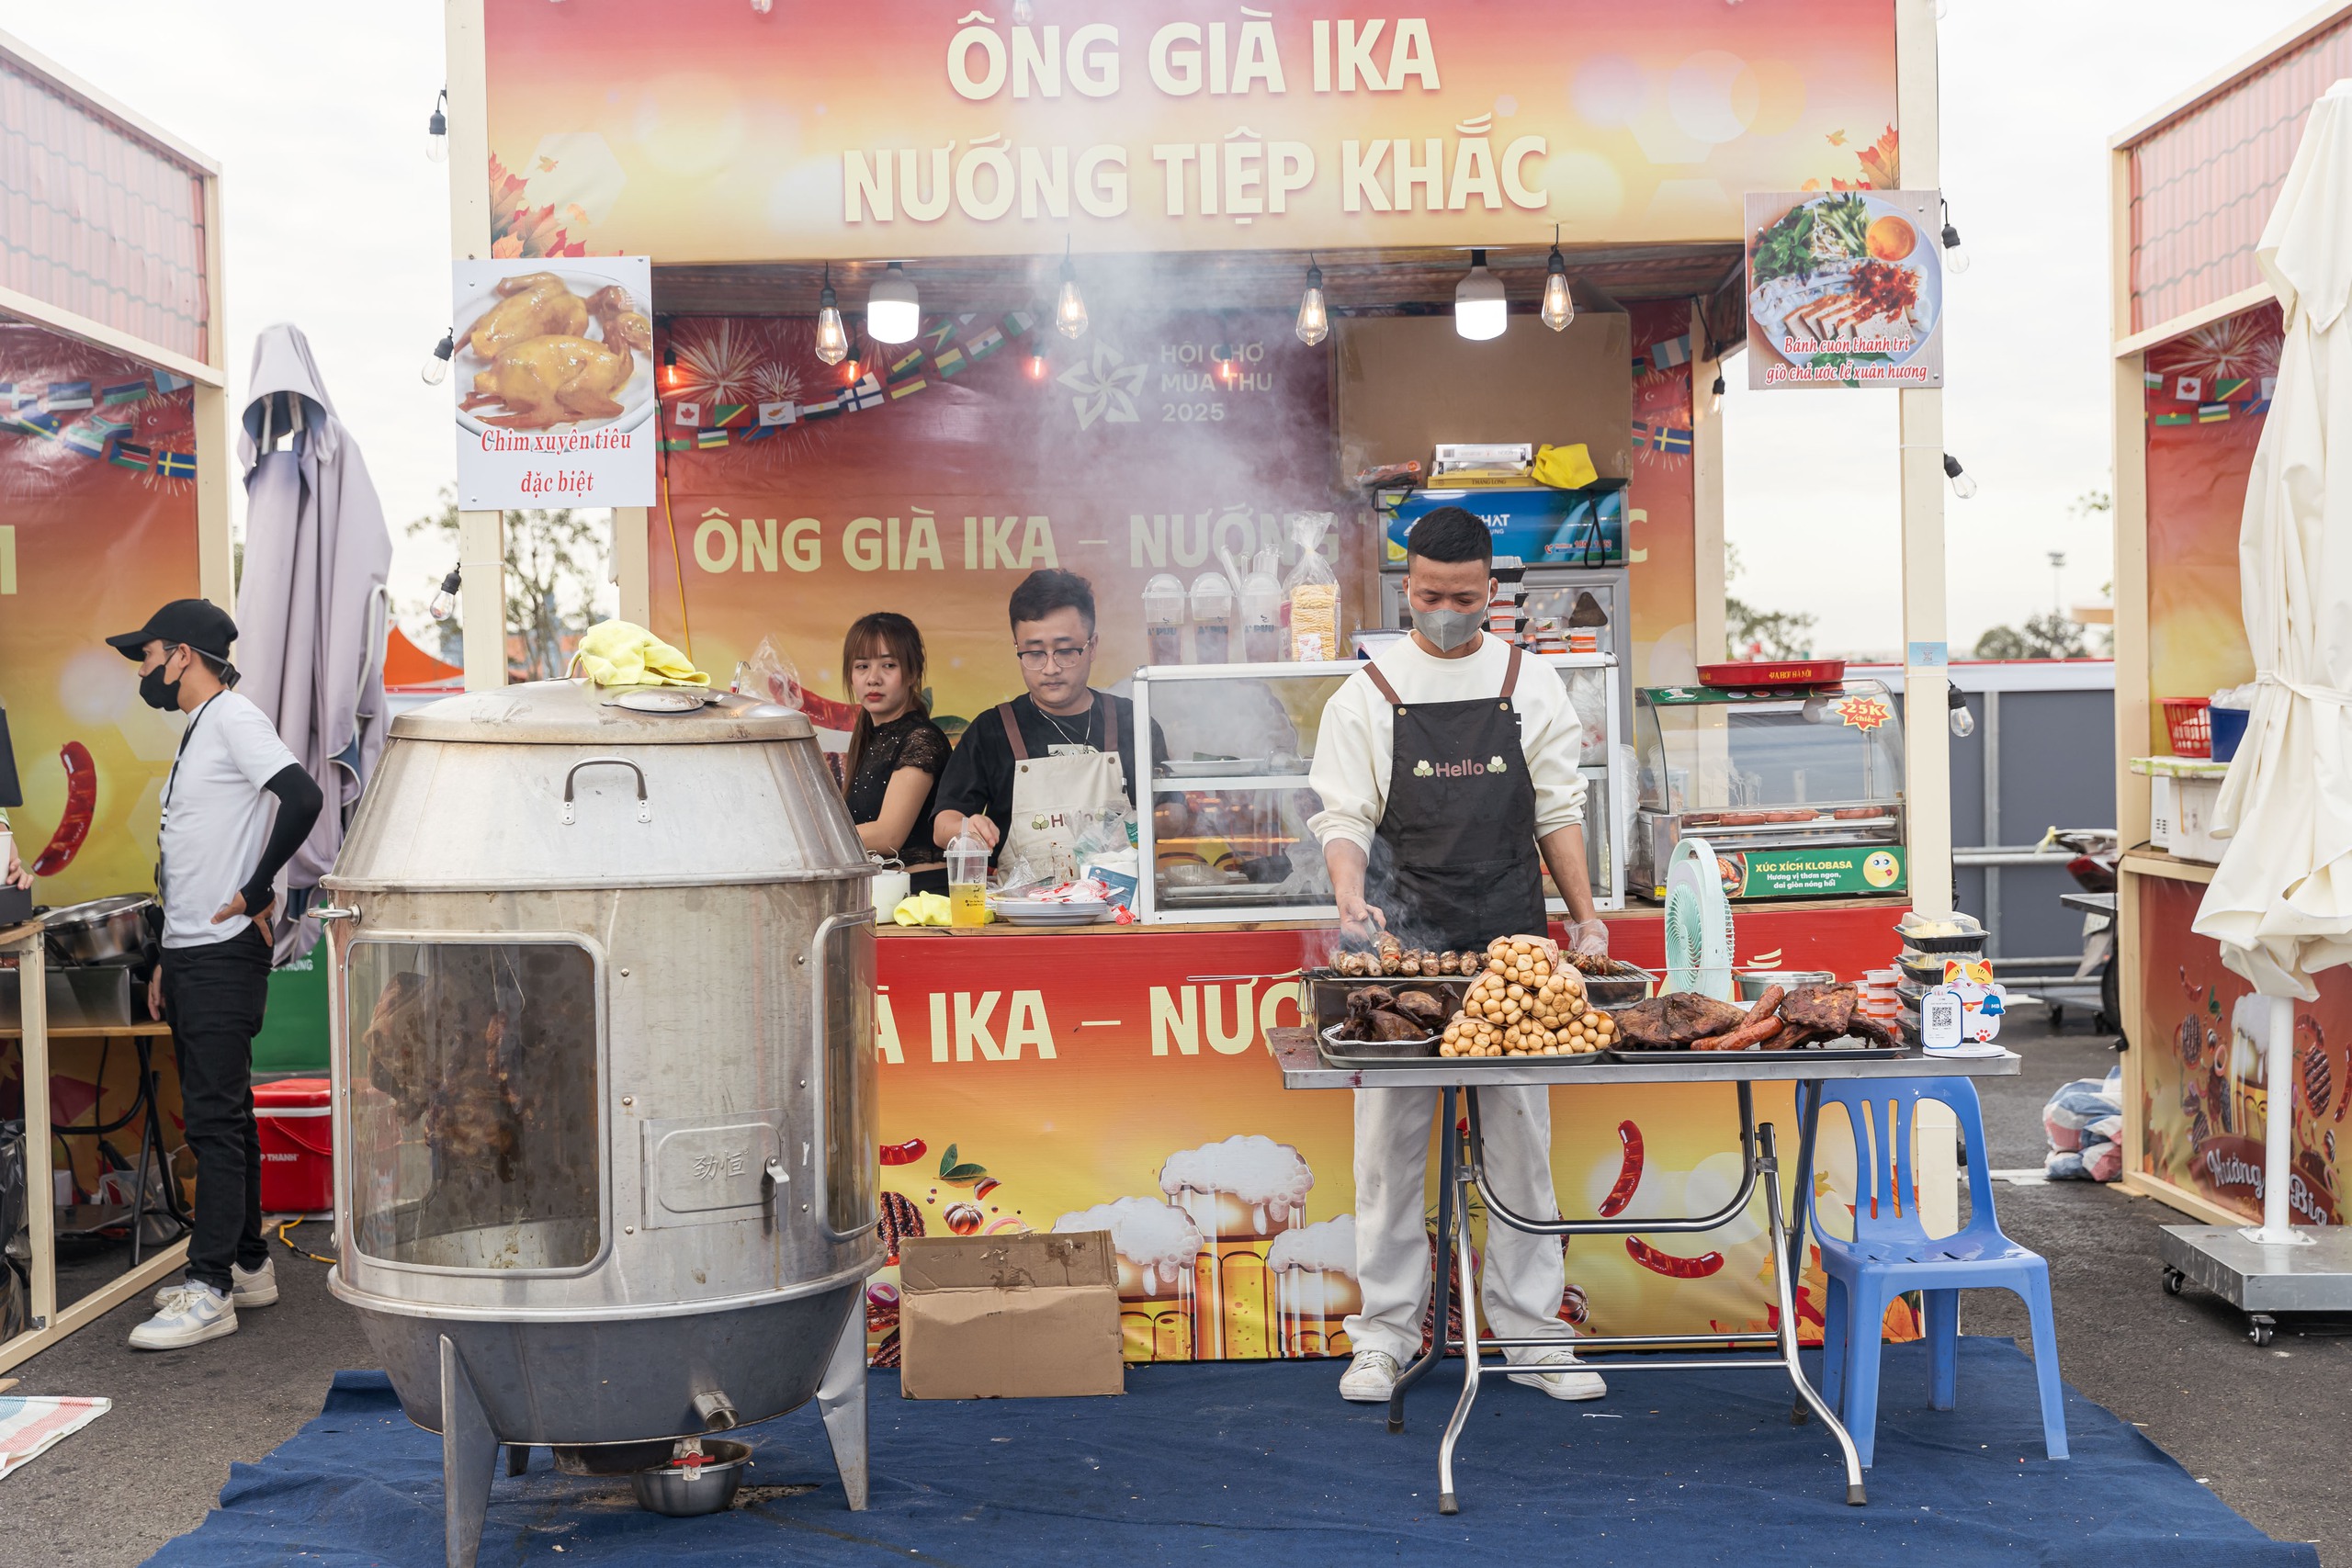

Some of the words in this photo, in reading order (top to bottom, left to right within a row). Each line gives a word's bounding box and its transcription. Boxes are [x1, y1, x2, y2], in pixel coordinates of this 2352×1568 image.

[946, 10, 1121, 100] ÔNG
[1148, 6, 1286, 96] GIÀ
[1311, 17, 1441, 92] IKA
[843, 131, 1128, 223] NƯỚNG
[1153, 126, 1315, 224] TIỆP
[1341, 113, 1548, 212] KHẮC
[1161, 341, 1203, 367] HỘI
[1784, 336, 1816, 353] Bánh
[1819, 334, 1850, 353] cuốn
[1852, 336, 1890, 352] thanh
[1893, 335, 1909, 351] trì
[1161, 369, 1216, 392] MÙA
[1225, 373, 1272, 391] THU
[1766, 365, 1786, 384] giò
[1789, 363, 1812, 379] chả
[1815, 365, 1837, 379] ước
[1839, 361, 1851, 378] lễ
[1854, 365, 1884, 378] xuân
[1888, 365, 1928, 381] hương
[1162, 403, 1225, 423] 2025
[481, 429, 530, 452] Chim
[534, 430, 590, 455] xuyên
[595, 428, 631, 449] tiêu
[521, 471, 553, 498] đặc
[559, 470, 594, 497] biệt
[693, 507, 821, 573] ÔNG
[842, 505, 944, 571] GIÀ
[965, 515, 1059, 570] IKA
[1131, 502, 1340, 570] NƯỚNG
[1847, 704, 1883, 716] 25K
[1436, 759, 1485, 777] Hello
[1756, 862, 1777, 873] XÚC
[1779, 861, 1803, 872] XÍCH
[1805, 861, 1853, 871] KLOBASA
[1767, 874, 1791, 882] Hương
[1787, 881, 1804, 889] giòn
[1804, 881, 1823, 889] nóng
[929, 989, 1057, 1063] IKA
[1149, 968, 1309, 1056] NƯỚ
[692, 1148, 746, 1181] 劲恒
